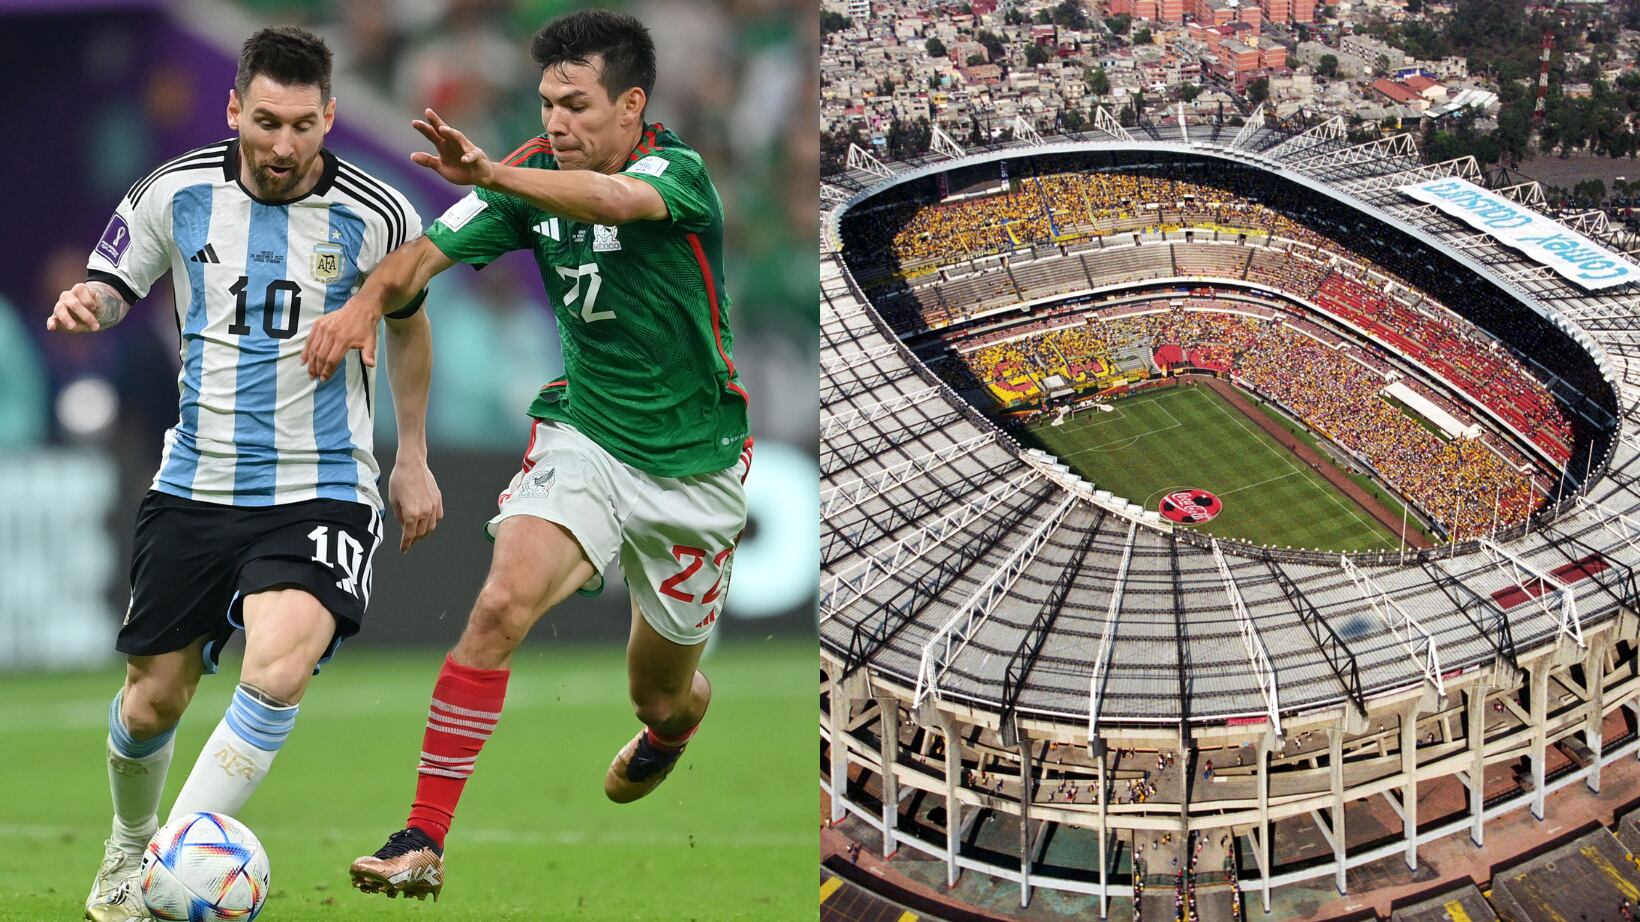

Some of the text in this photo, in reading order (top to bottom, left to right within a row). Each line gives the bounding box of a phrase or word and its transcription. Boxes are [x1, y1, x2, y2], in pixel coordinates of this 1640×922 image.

[317, 254, 336, 273] AFA
[1516, 233, 1629, 280] Comex
[228, 276, 302, 339] 10
[555, 262, 617, 323] 22
[307, 525, 364, 585] 10
[659, 545, 735, 604] 22
[213, 742, 256, 780] AFA
